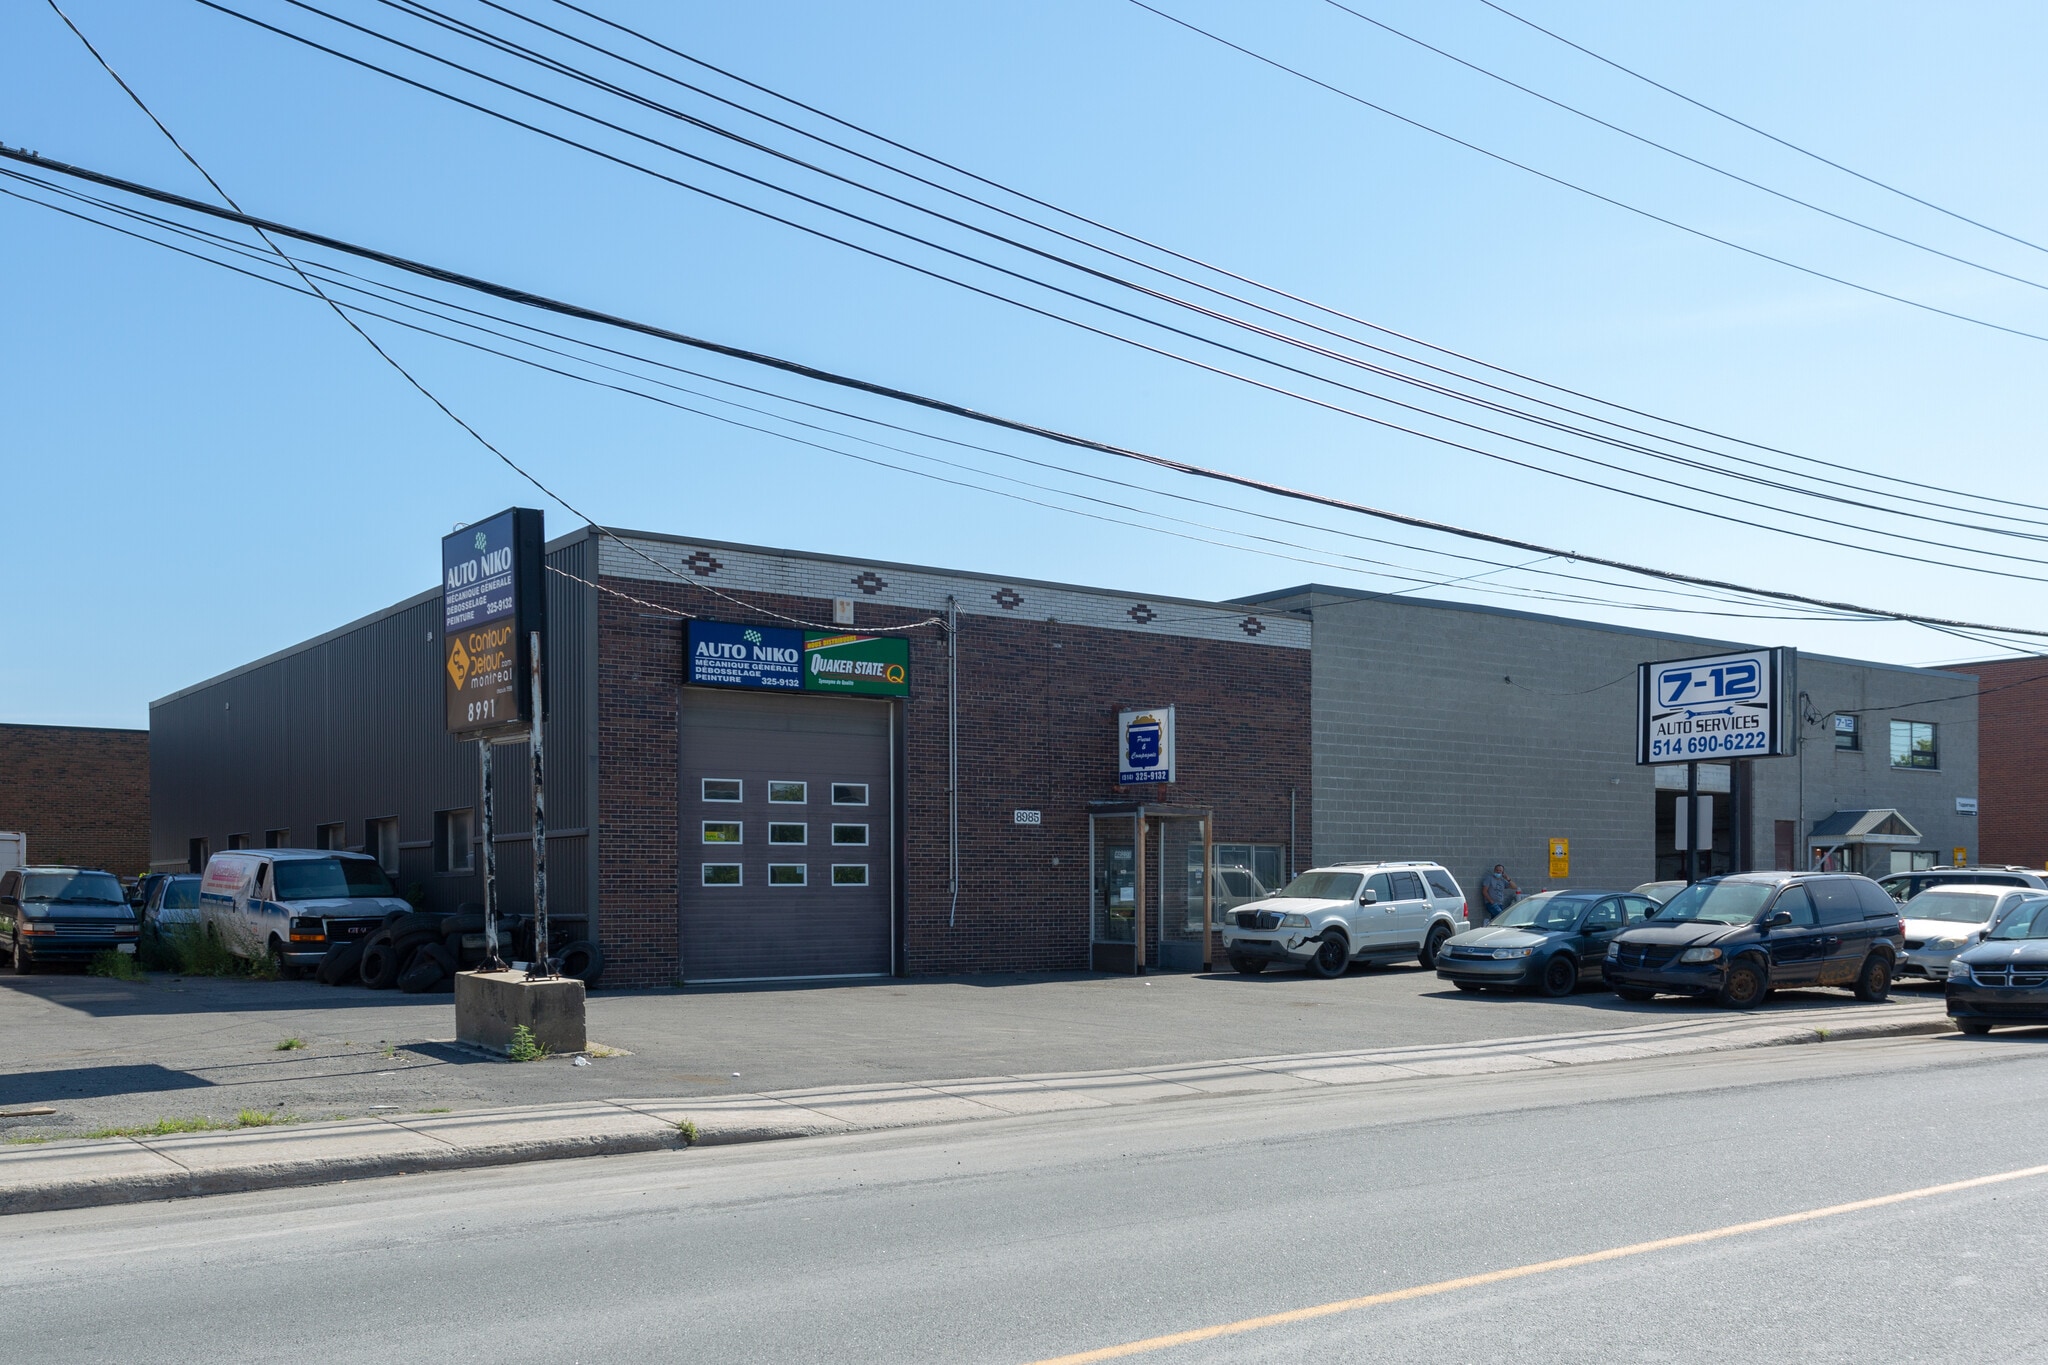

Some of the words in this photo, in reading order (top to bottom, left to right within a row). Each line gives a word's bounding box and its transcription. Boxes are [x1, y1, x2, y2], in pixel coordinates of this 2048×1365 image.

[447, 559, 478, 590] AUTO
[481, 546, 511, 578] NIKO
[446, 586, 480, 605] MÉCANIQUE
[480, 575, 512, 593] GÉNÉRALE
[446, 595, 487, 615] DÉBOSSELAGE
[486, 596, 513, 615] 325-9132
[446, 611, 475, 626] PEINTURE
[469, 626, 512, 653] Contour
[696, 641, 747, 659] AUTO
[753, 645, 799, 663] NIKO
[695, 658, 750, 670] MÉCANIQUE
[751, 663, 799, 673] GÉNÉRALE
[695, 666, 762, 677] DÉBOSSELAGE
[810, 653, 853, 676] QUAKER
[854, 661, 885, 677] STATE
[470, 668, 513, 689] montreal
[695, 673, 742, 683] PEINTURE
[761, 677, 800, 687] 325-9132
[1663, 664, 1756, 702] 7-12
[468, 699, 495, 722] 8991
[1657, 720, 1692, 736] AUTO
[1696, 715, 1760, 733] SERVICES
[1836, 717, 1853, 728] 7-12
[1652, 738, 1683, 756] 514
[1687, 731, 1766, 754] 690-6222
[1135, 770, 1167, 781] 325-9132
[1016, 811, 1040, 822] 8985
